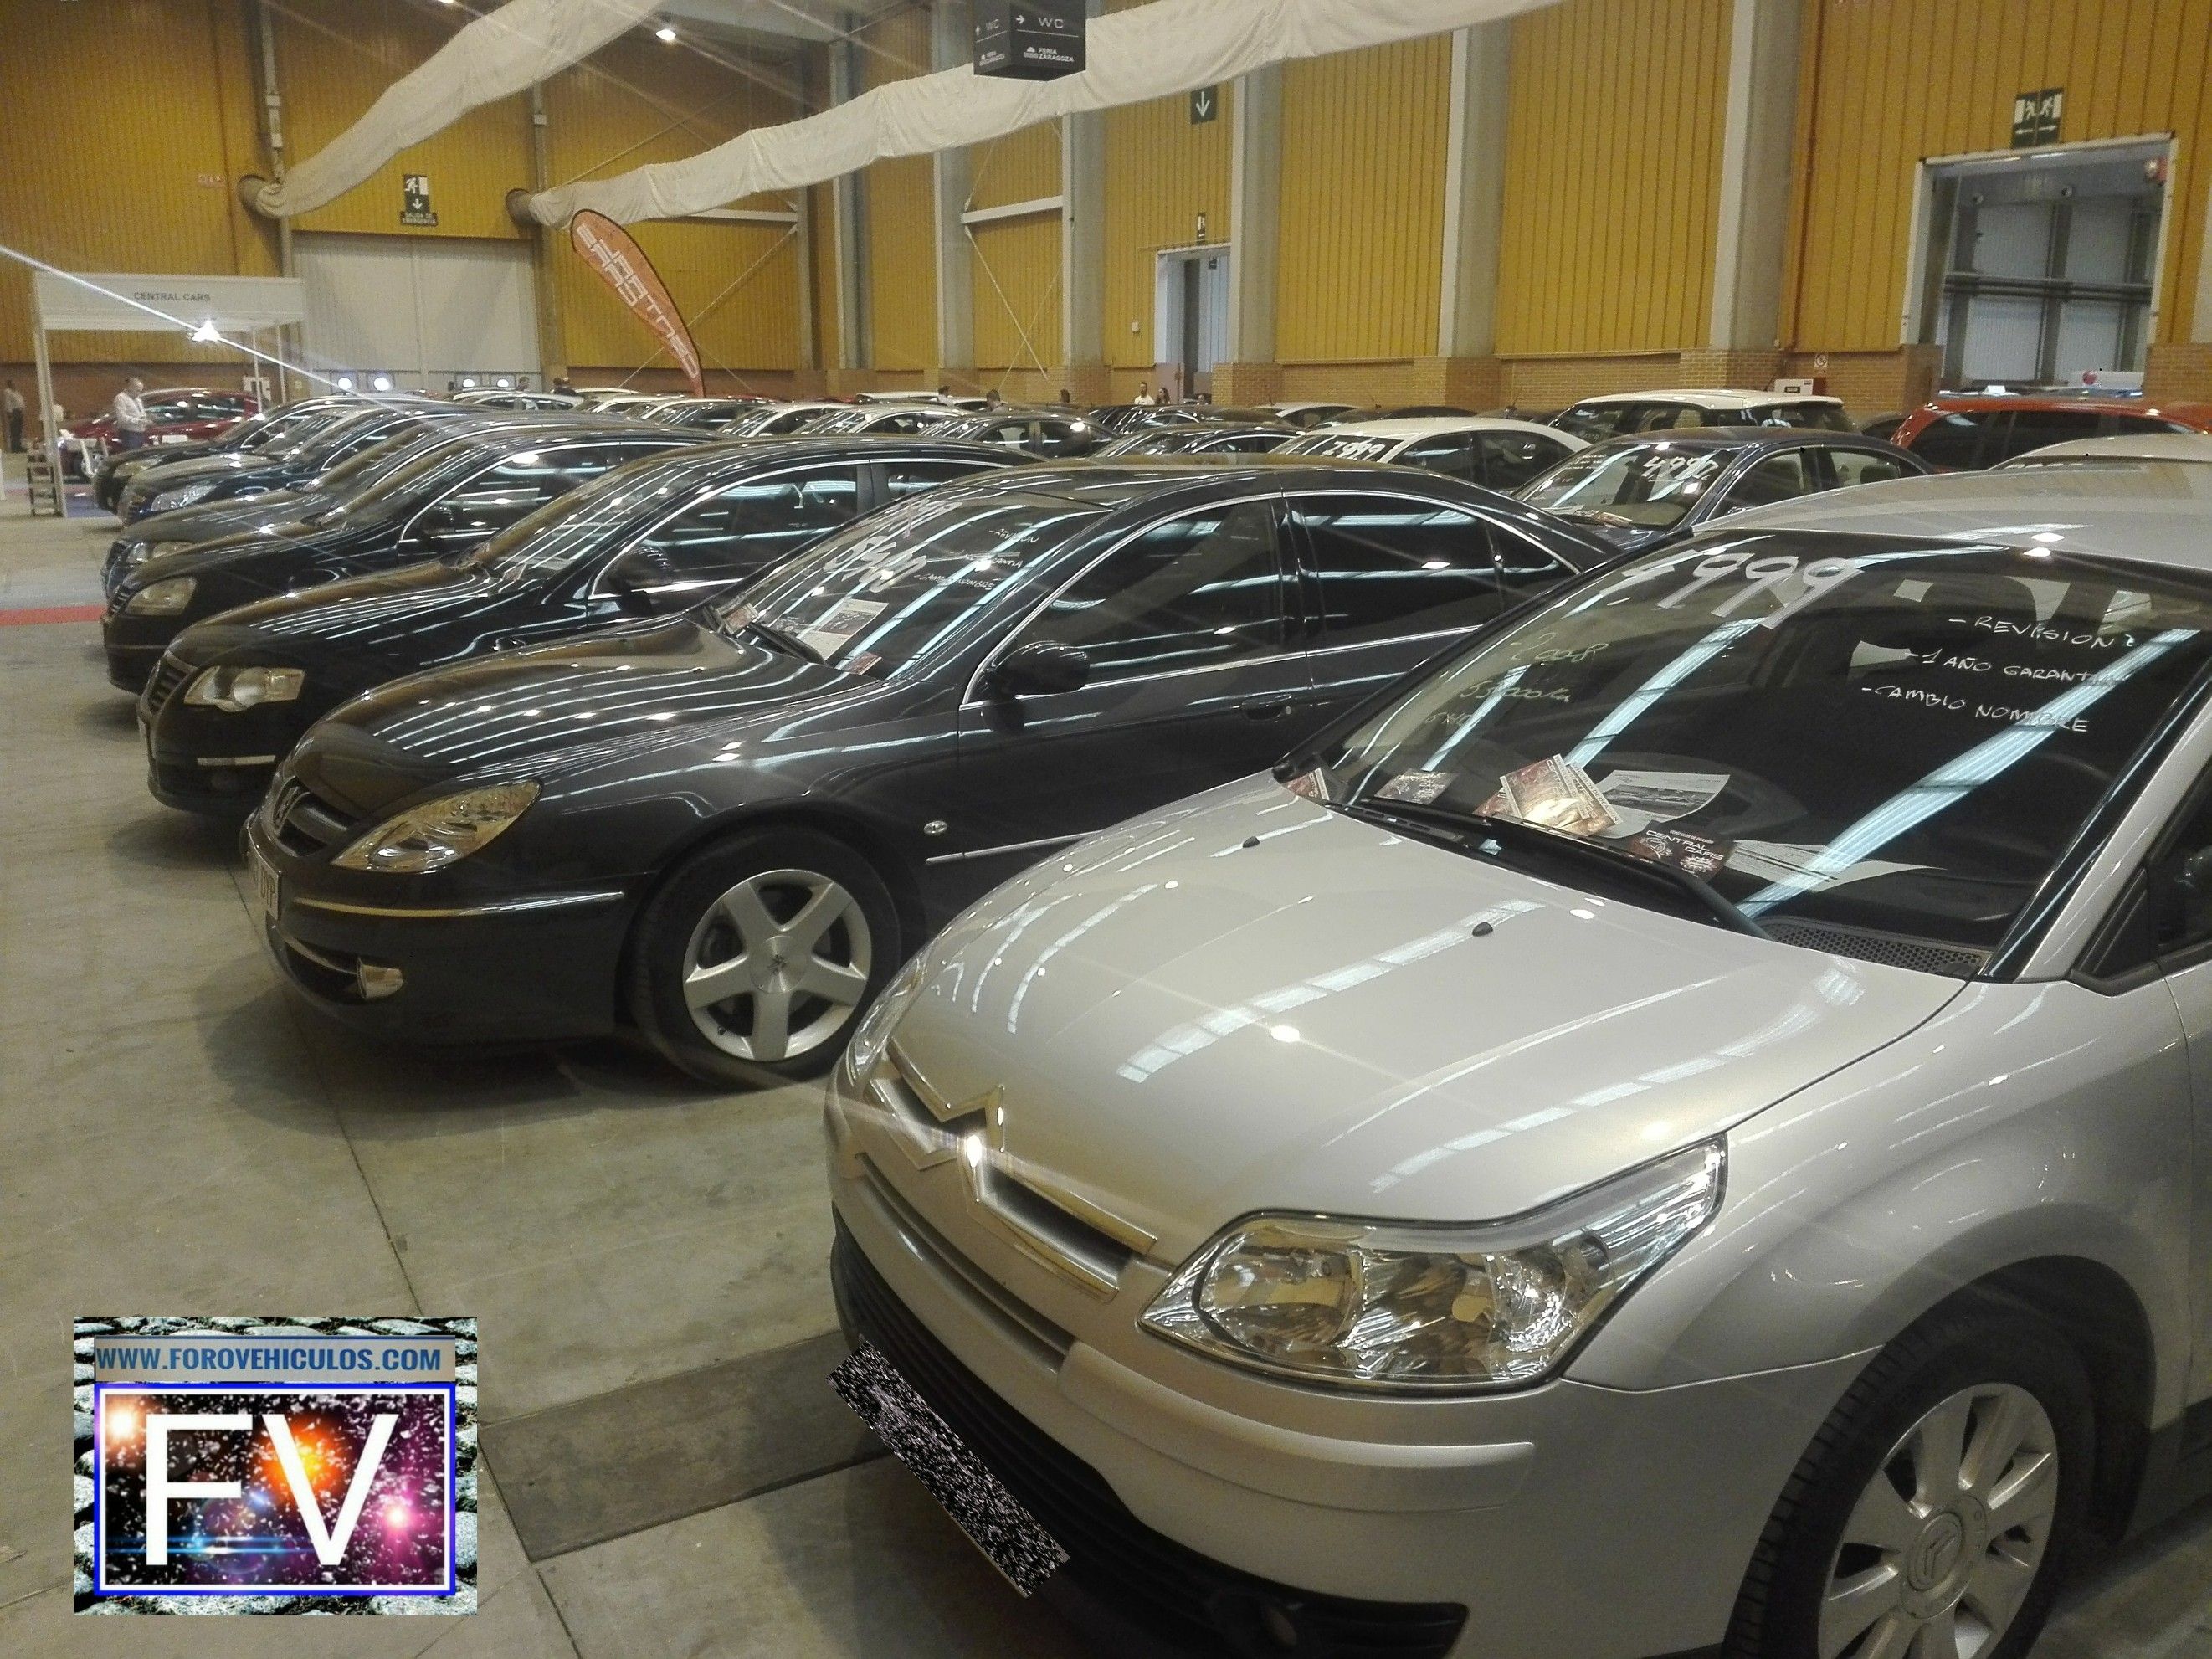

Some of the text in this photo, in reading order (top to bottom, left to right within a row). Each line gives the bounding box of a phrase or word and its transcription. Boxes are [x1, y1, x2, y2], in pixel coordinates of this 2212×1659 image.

[1038, 17, 1065, 28] WC
[133, 291, 211, 302] CENTRAL CARS
[1943, 657, 1992, 672] AÑO
[1645, 830, 1711, 852] CENTRAL
[1684, 845, 1725, 860] CARS
